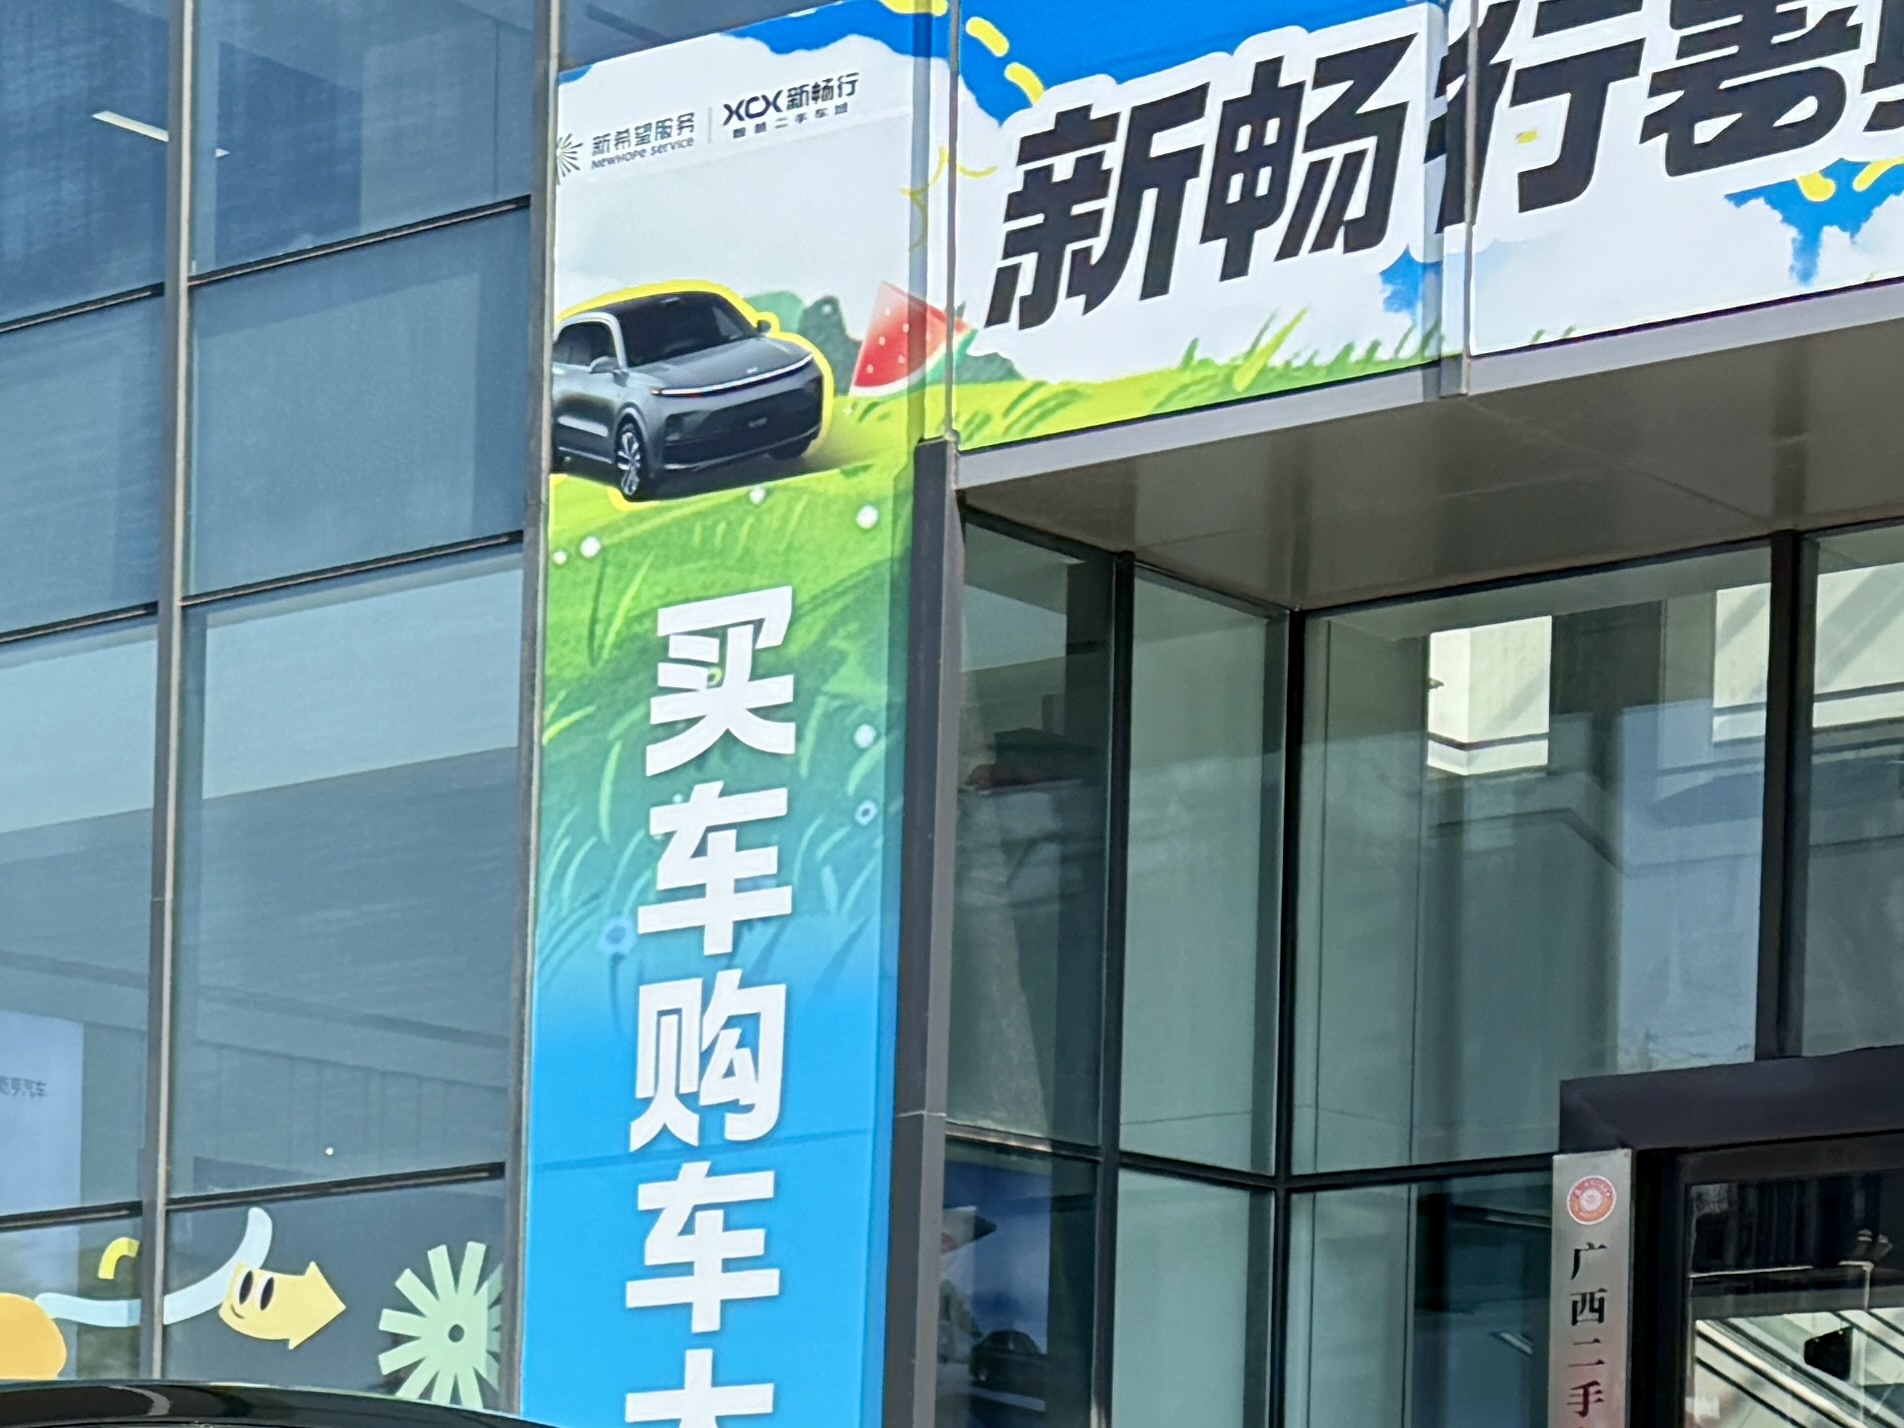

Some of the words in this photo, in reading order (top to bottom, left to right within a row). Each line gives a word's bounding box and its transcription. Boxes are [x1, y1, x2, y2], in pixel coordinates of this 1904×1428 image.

[786, 72, 860, 111] 新畅行
[592, 112, 695, 157] 新希望服务
